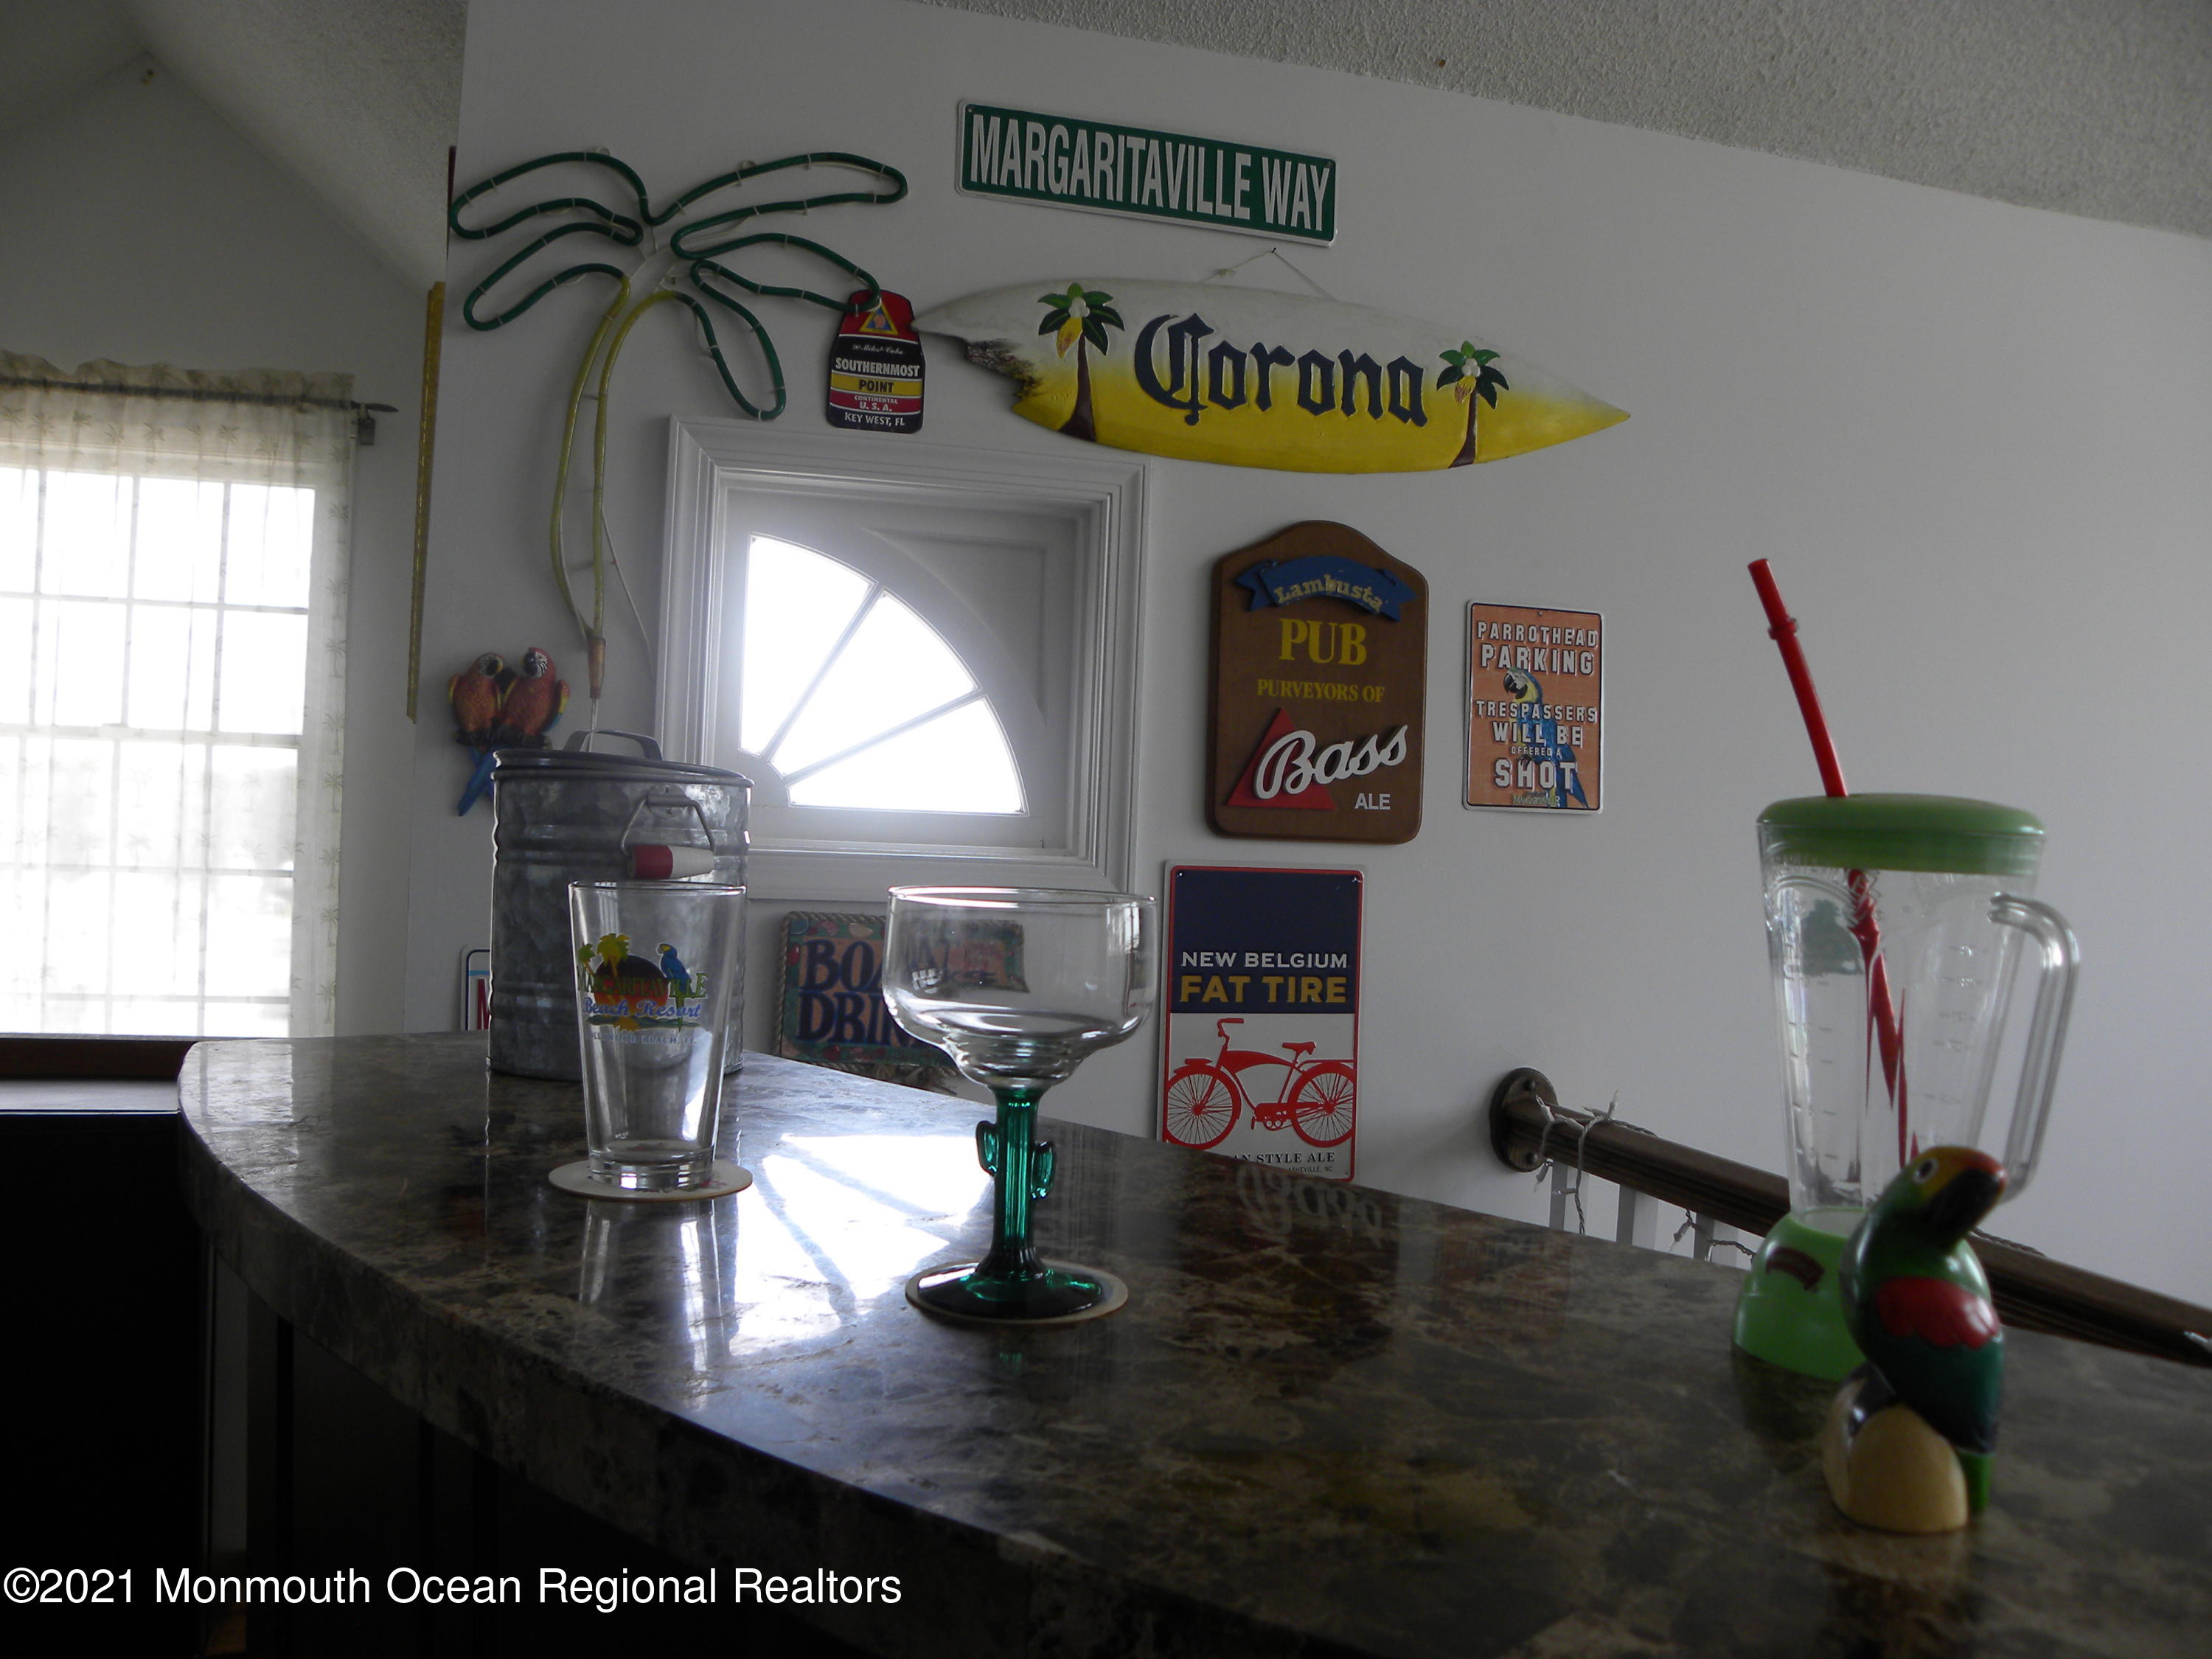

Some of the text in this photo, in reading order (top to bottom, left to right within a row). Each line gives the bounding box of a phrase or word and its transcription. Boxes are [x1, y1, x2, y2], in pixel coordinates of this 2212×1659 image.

[970, 114, 1330, 231] MARGARITAVILLE WAY
[835, 358, 920, 377] SOUTHERNMOST
[1134, 313, 1428, 426] Corona
[859, 379, 894, 392] POINT
[854, 394, 898, 405] CONTINENTAL
[844, 411, 863, 422] KEY
[865, 414, 891, 427] WEST,
[1274, 574, 1385, 613] Lambusta
[1279, 618, 1368, 665] PUB
[1477, 621, 1599, 647] PARROTHEAD
[1481, 644, 1594, 675] PARKING
[1257, 678, 1385, 703] PURVEYORS OF
[1475, 700, 1598, 723] TRESPASSERS
[1492, 721, 1583, 746] WILL BE
[1255, 725, 1408, 800] Bass
[1511, 746, 1562, 758] OFFERED A
[1495, 759, 1577, 790] SHOT
[1354, 793, 1391, 811] ALE
[1180, 951, 1348, 969] NEW BELGIUM
[1180, 975, 1348, 1004] FAT TIRE
[584, 996, 702, 1018] Beach Resort
[1256, 1153, 1303, 1164] STYLE
[1307, 1152, 1335, 1163] ALE
